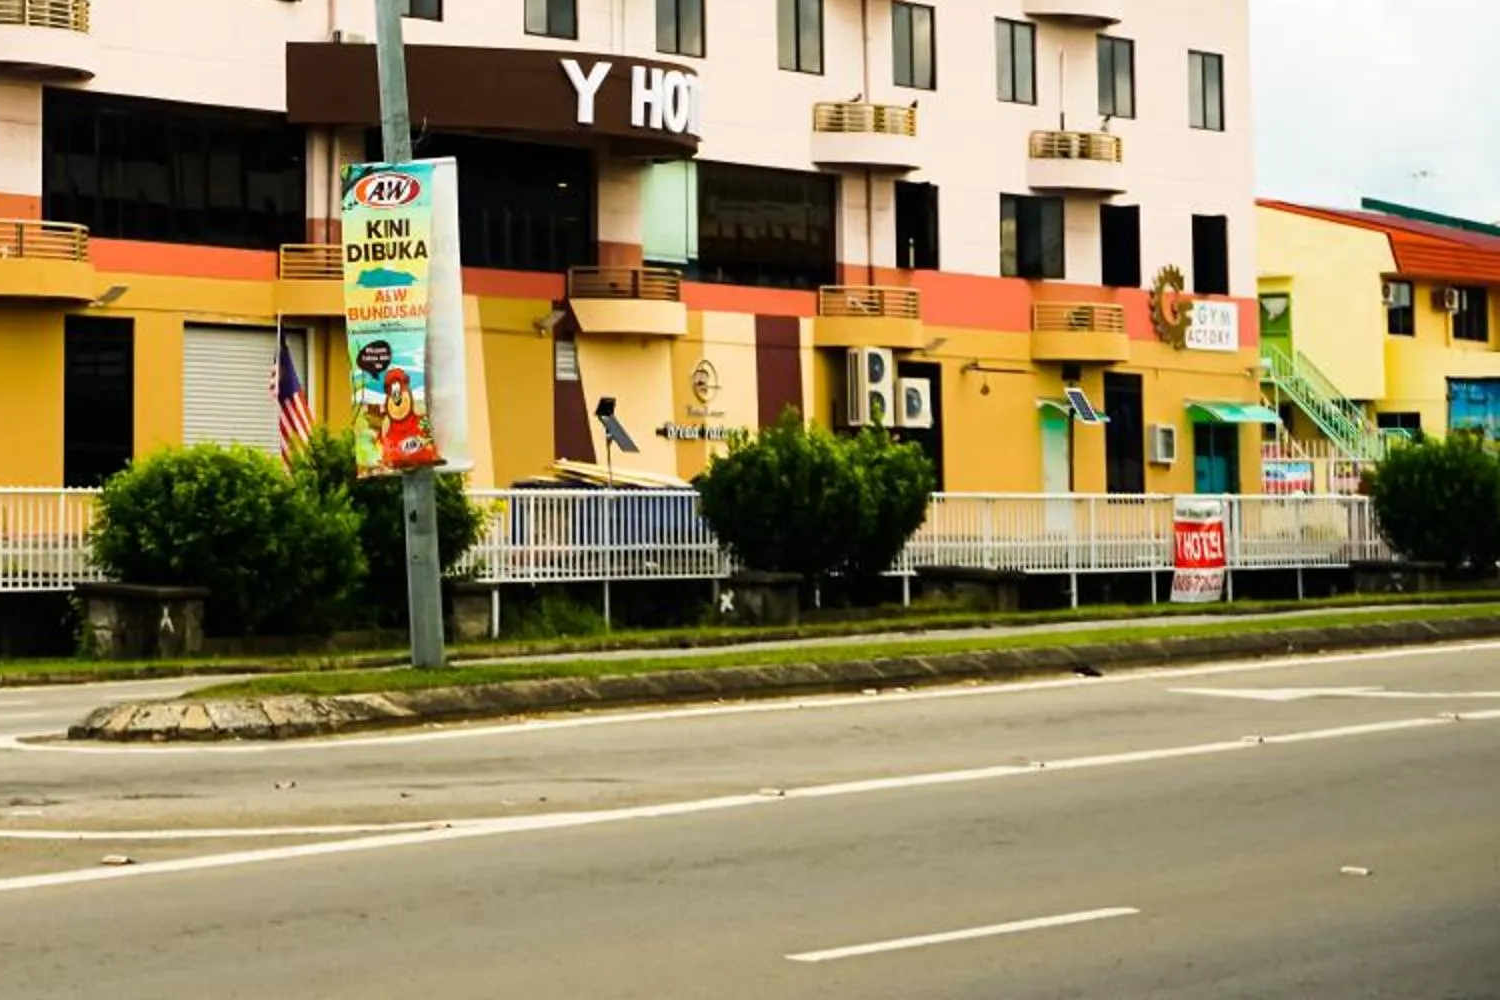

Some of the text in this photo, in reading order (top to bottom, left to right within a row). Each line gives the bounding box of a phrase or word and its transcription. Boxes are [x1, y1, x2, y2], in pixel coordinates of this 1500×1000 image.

[560, 58, 613, 124] Y
[366, 218, 410, 239] KINI
[347, 240, 428, 263] DIBUKA
